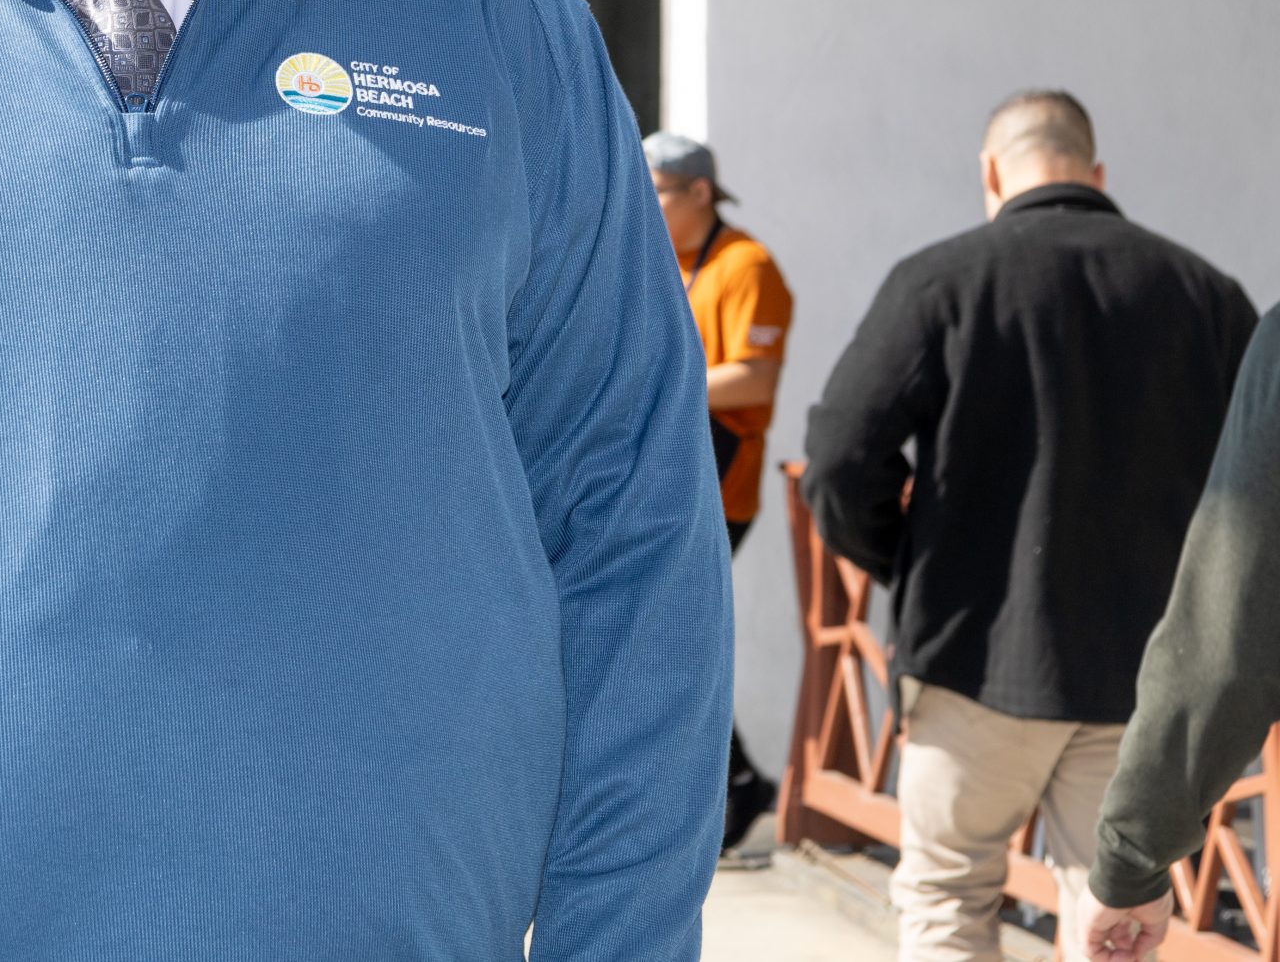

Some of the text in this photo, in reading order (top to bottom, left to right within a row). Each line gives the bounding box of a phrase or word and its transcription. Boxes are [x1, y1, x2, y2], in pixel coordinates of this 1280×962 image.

[350, 61, 400, 76] CITY OF
[353, 72, 441, 97] HERMOSA
[355, 87, 414, 109] BEACH
[356, 106, 487, 137] Community Resources
